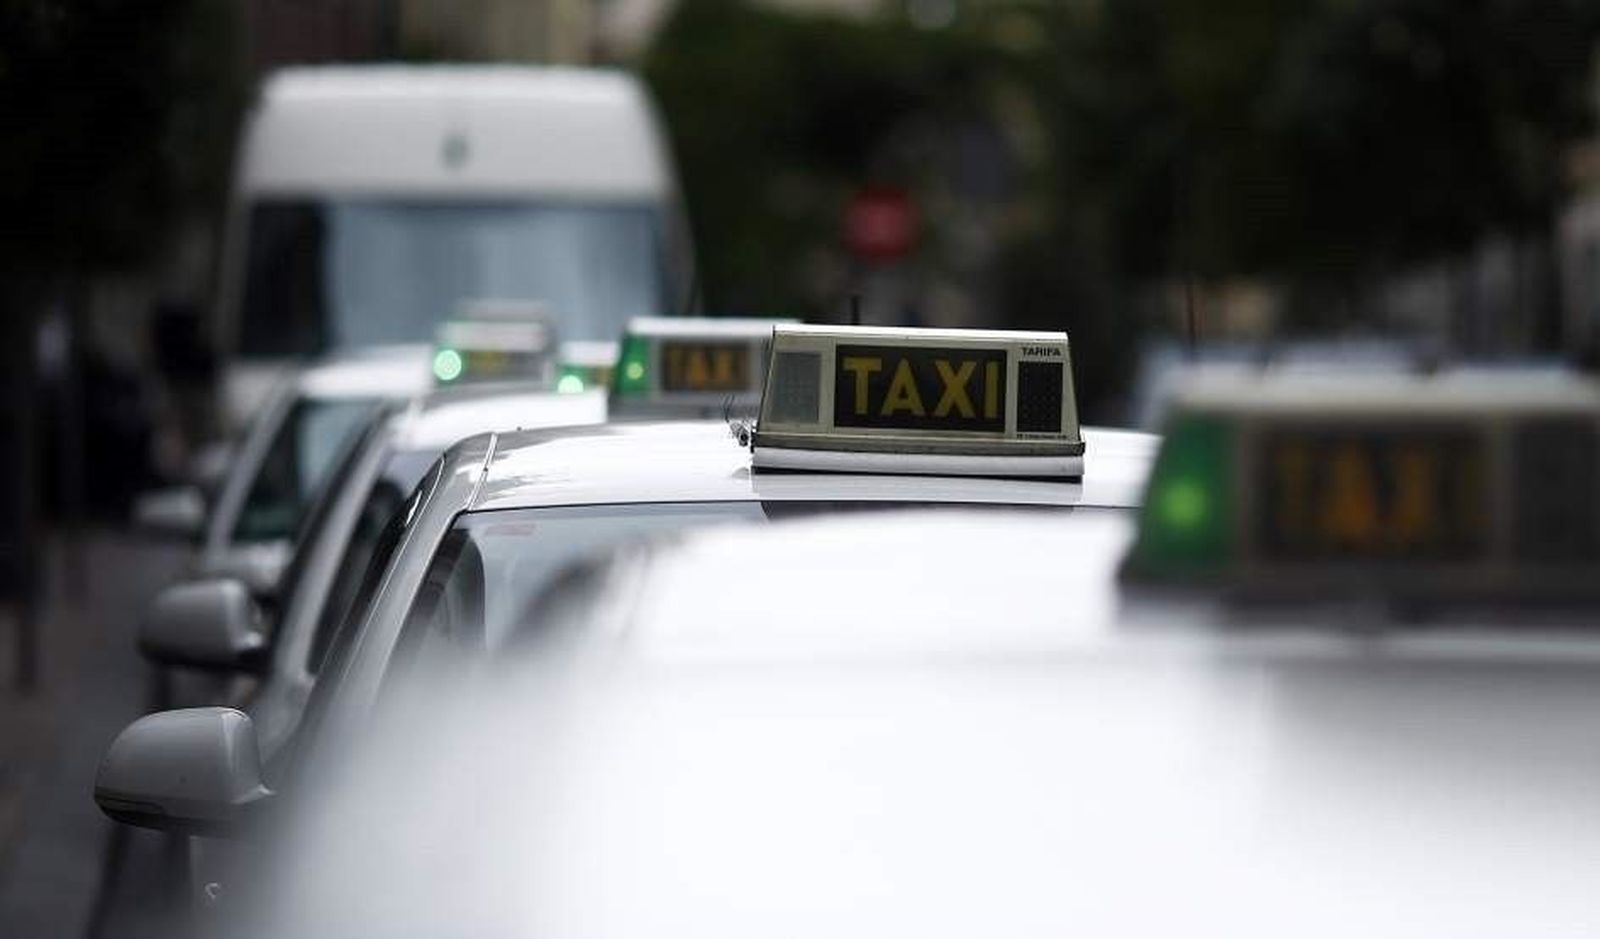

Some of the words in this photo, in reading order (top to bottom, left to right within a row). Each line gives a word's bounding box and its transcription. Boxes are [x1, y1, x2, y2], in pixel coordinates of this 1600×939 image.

[666, 343, 749, 389] TAXI
[1021, 346, 1062, 356] TARIFA
[843, 357, 1000, 418] TAXI
